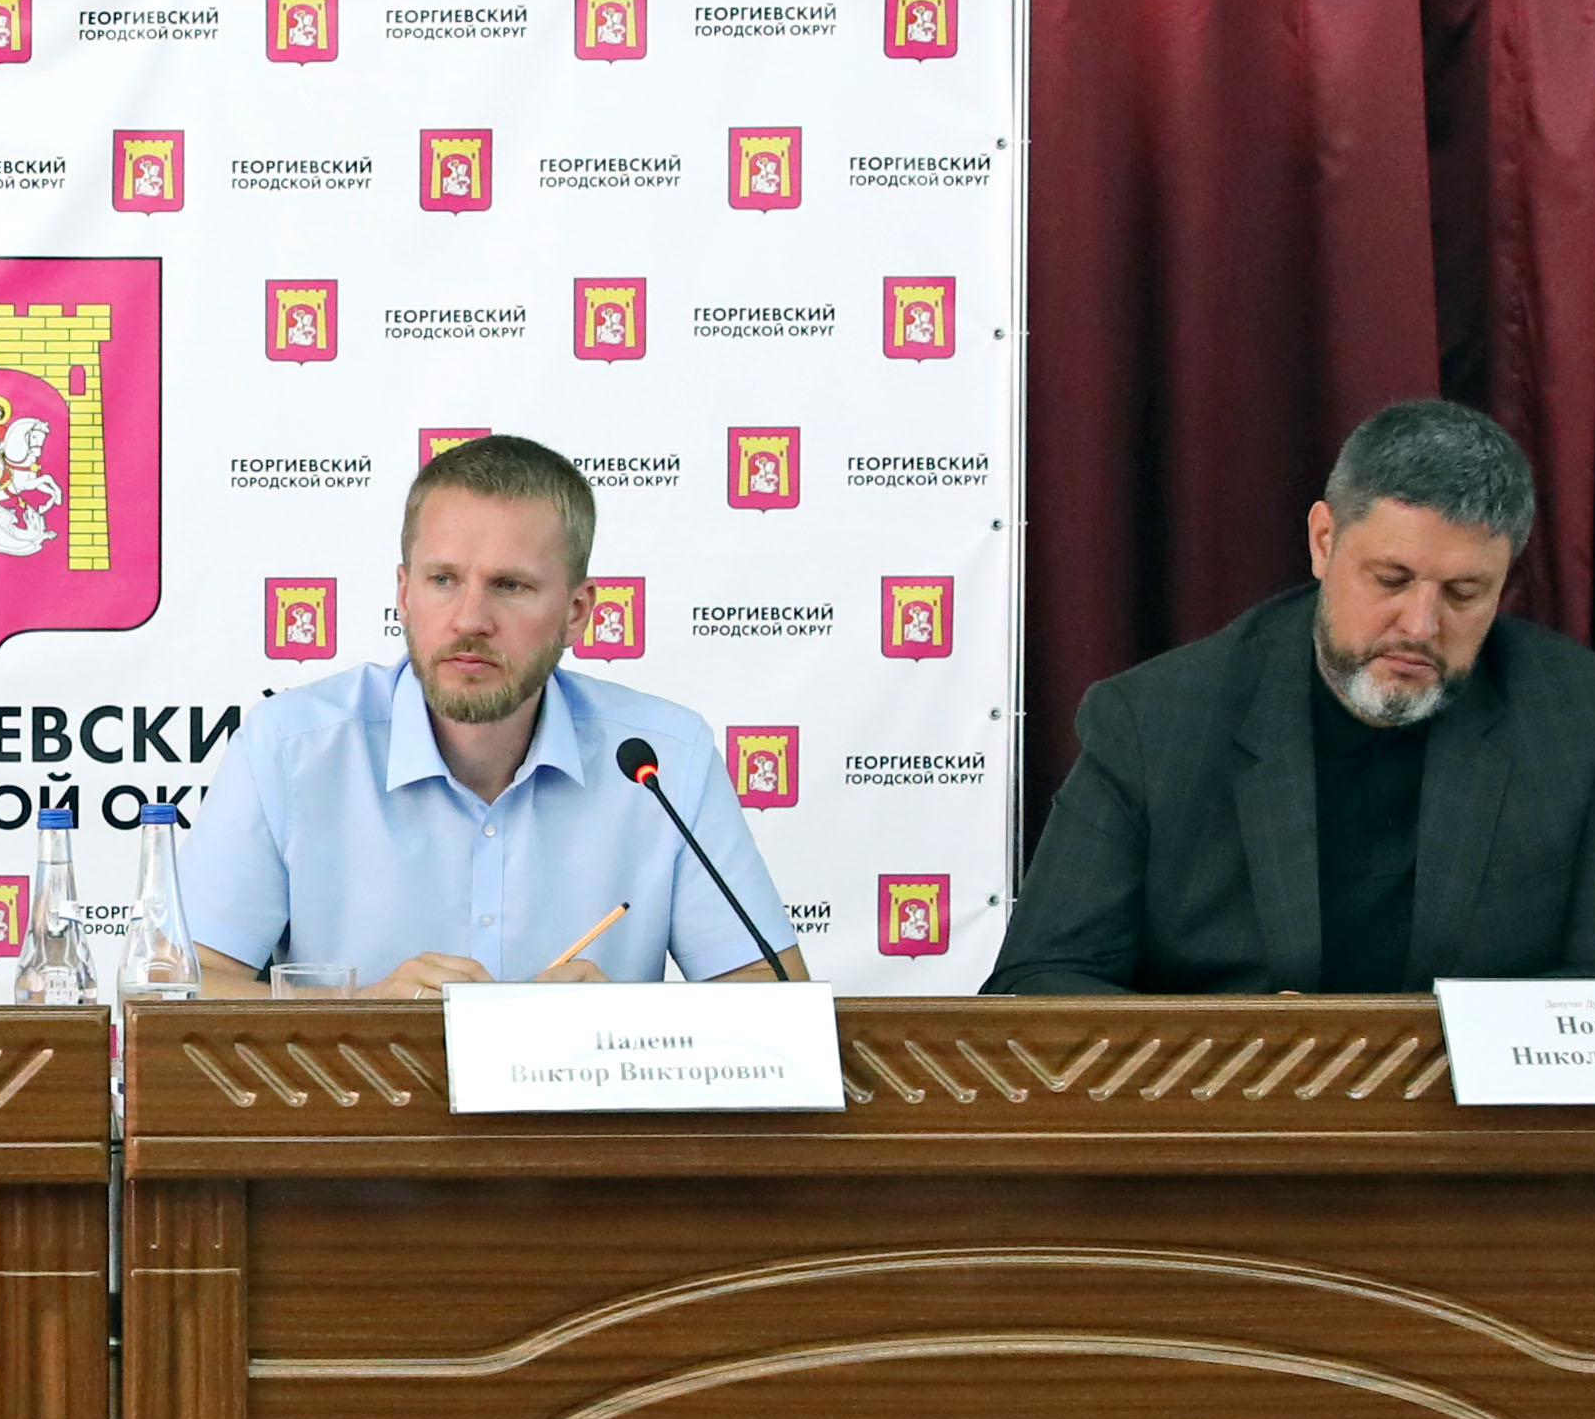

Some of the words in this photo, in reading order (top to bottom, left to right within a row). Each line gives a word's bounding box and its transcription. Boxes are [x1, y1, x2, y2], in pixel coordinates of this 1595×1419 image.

[79, 8, 219, 25] ГЕОРГИЕВСКИЙ
[386, 7, 527, 24] ГЕОРГИЕВСКИЙ
[695, 4, 836, 21] ГЕОРГИЕВСКИЙ
[79, 27, 168, 41] ГОРОДСКОЙ
[173, 29, 217, 40] ОКРУГ
[386, 25, 475, 39] ГОРОДСКОЙ
[480, 27, 526, 38] ОКРУГ
[695, 22, 784, 37] ГОРОДСКОЙ
[789, 24, 834, 36] ОКРУГ
[232, 157, 372, 174] ГЕОРГИЕВСКИЙ
[540, 156, 681, 173] ГЕОРГИЕВСКИЙ
[850, 154, 991, 171] ГЕОРГИЕВСКИЙ
[20, 178, 64, 189] ОКРУГ
[232, 176, 321, 190] ГОРОДСКОЙ
[326, 178, 370, 189] ОКРУГ
[540, 174, 629, 188] ГОРОДСКОЙ
[634, 176, 679, 187] ОКРУГ
[850, 173, 939, 187] ГОРОДСКОЙ
[944, 175, 988, 186] ОКРУГ
[385, 307, 526, 324] ГЕОРГИЕВСКИЙ
[694, 305, 835, 322] ГЕОРГИЕВСКИЙ
[385, 325, 474, 339] ГОРОДСКОЙ
[479, 327, 524, 338] ОКРУГ
[694, 323, 783, 337] ГОРОДСКОЙ
[788, 325, 834, 336] ОКРУГ
[231, 456, 371, 473] ГЕОРГИЕВСКИЙ
[573, 454, 681, 472] РГИЕВСКИЙ
[848, 454, 989, 471] ГЕОРГИЕВСКИЙ
[231, 475, 320, 489] ГОРОДСКОЙ
[325, 477, 370, 488] ОКРУГ
[633, 476, 679, 487] ОКРУГ
[848, 473, 937, 487] ГОРОДСКОЙ
[942, 475, 986, 486] ОКРУГ
[692, 604, 833, 621] ГЕОРГИЕВСКИЙ
[692, 623, 781, 637] ГОРОДСКОЙ
[786, 625, 832, 636] ОКРУГ
[846, 753, 985, 770] ГЕОРГИЕВСКИЙ
[846, 771, 935, 785] ГОРОДСКОЙ
[940, 773, 984, 784] ОКРУГ
[512, 1066, 609, 1087] Виктор
[621, 1062, 784, 1085] Викторович
